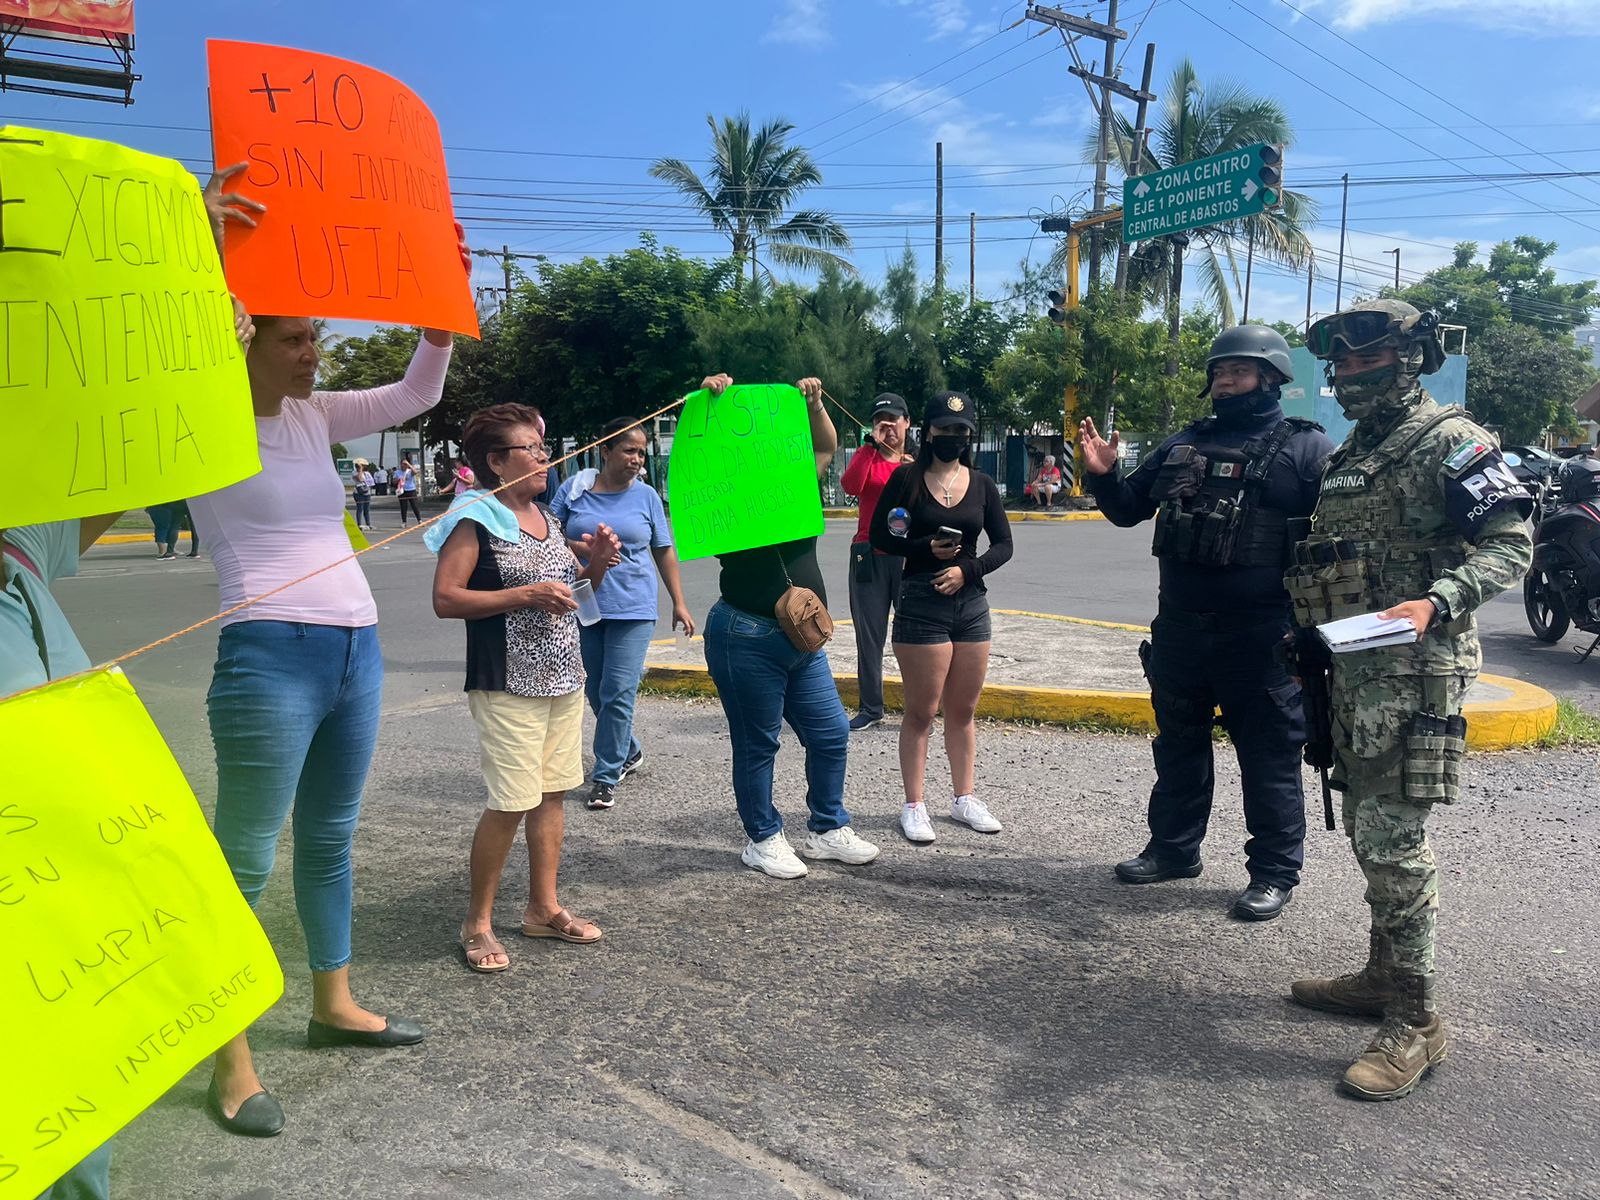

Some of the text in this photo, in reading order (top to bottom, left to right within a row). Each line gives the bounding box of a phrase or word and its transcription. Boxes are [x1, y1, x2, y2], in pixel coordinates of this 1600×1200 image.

[249, 68, 439, 164] +10 AÑOS
[247, 142, 324, 192] SIN
[1155, 153, 1250, 192] ZONA CENTRO
[0, 137, 214, 273] EXIGIMOS
[1128, 198, 1239, 236] CENTRAL DE ABASTOS
[1133, 179, 1232, 216] EJE 1 PONIENTE
[291, 224, 424, 300] UFIA
[0, 290, 236, 389] INTENDENTE
[688, 385, 781, 439] LA SEP
[67, 403, 206, 497] UFIA
[675, 432, 815, 487] NO DA RESPUESTA
[682, 480, 737, 510] DELEGADA
[1323, 475, 1365, 491] MARINA
[1461, 462, 1519, 501] PN
[1467, 490, 1509, 522] POLICIA
[690, 481, 797, 544] DIANA HUESCAS
[98, 803, 168, 845] UNA
[26, 908, 188, 1002] LIMPIA
[32, 1095, 98, 1151] SIN
[115, 964, 258, 1084] INTENDENTE
